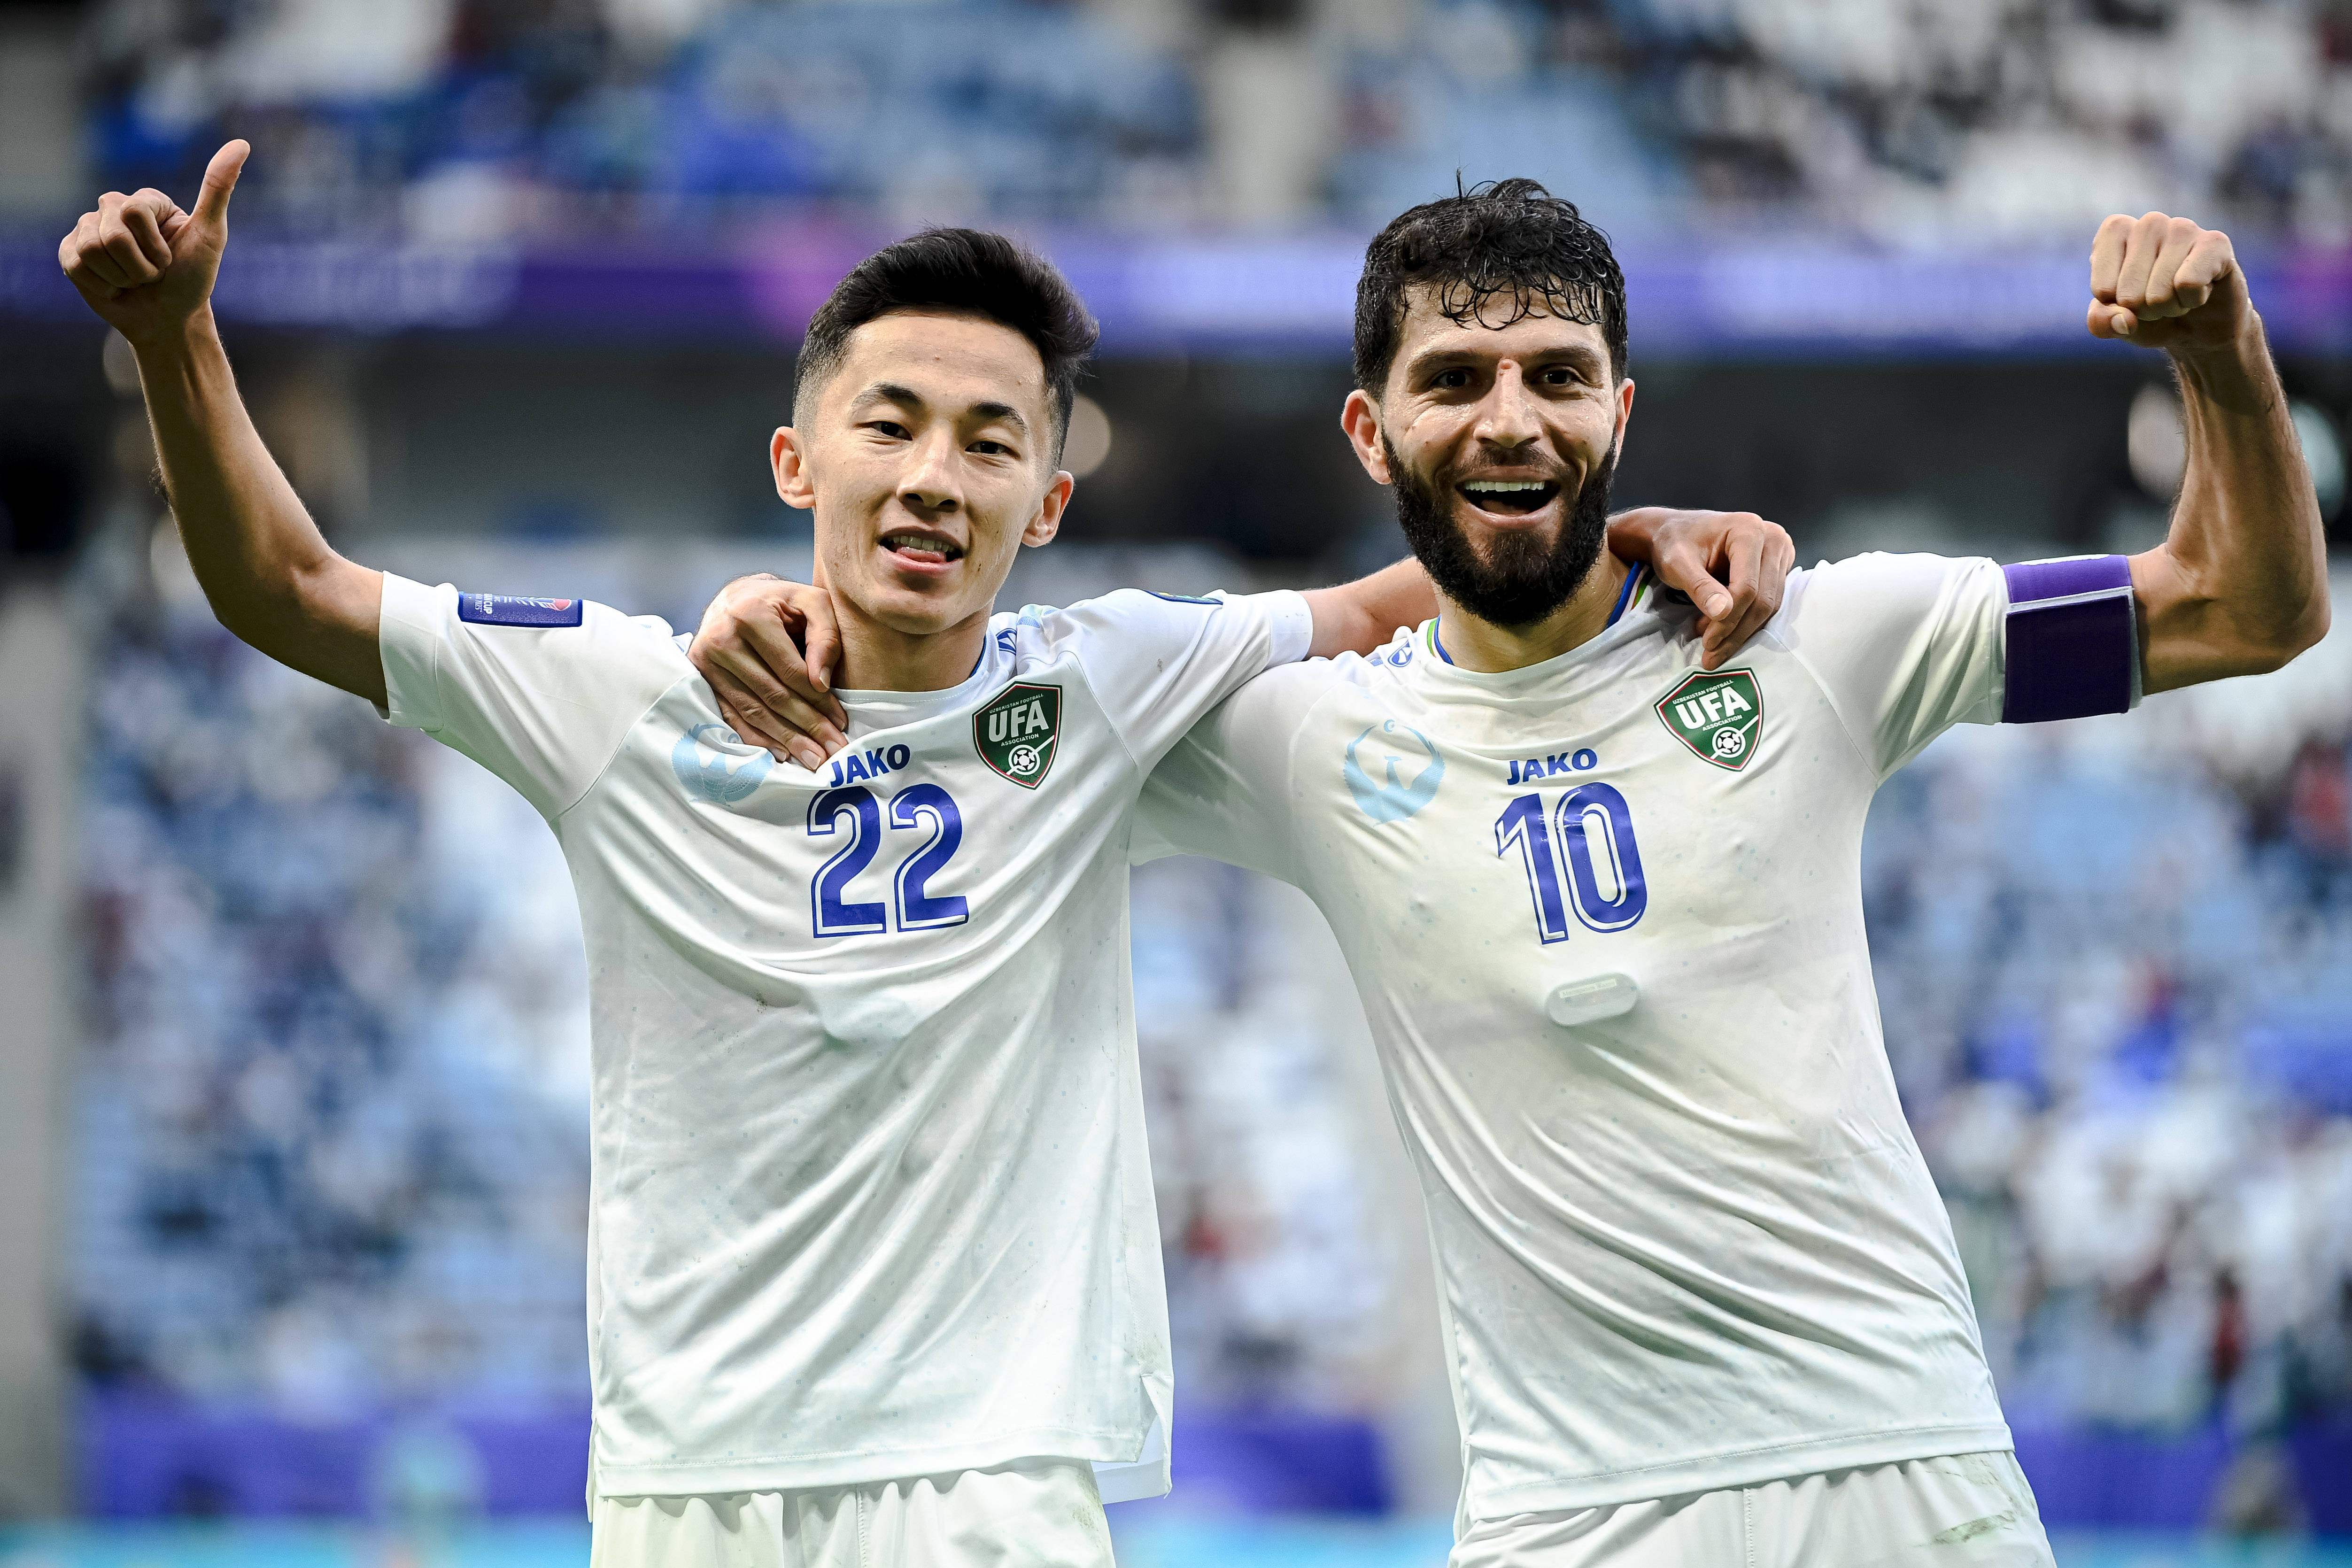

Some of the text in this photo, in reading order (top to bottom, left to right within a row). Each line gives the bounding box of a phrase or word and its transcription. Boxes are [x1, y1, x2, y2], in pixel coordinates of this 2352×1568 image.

[483, 601, 493, 614] CUP
[989, 693, 1044, 714] UZBEKISTAN FOOTBALL
[1672, 680, 1734, 704] UZBEKISTAN FOOTBALL
[1674, 686, 1752, 729] UFA
[989, 700, 1049, 742] UFA
[1702, 715, 1743, 731] ASSOCIATION
[1001, 733, 1039, 747] ASSOCIATION
[830, 744, 911, 788] JAKO
[1507, 748, 1598, 785] JAKO
[807, 783, 969, 938] 22
[1495, 782, 1648, 945] 10
